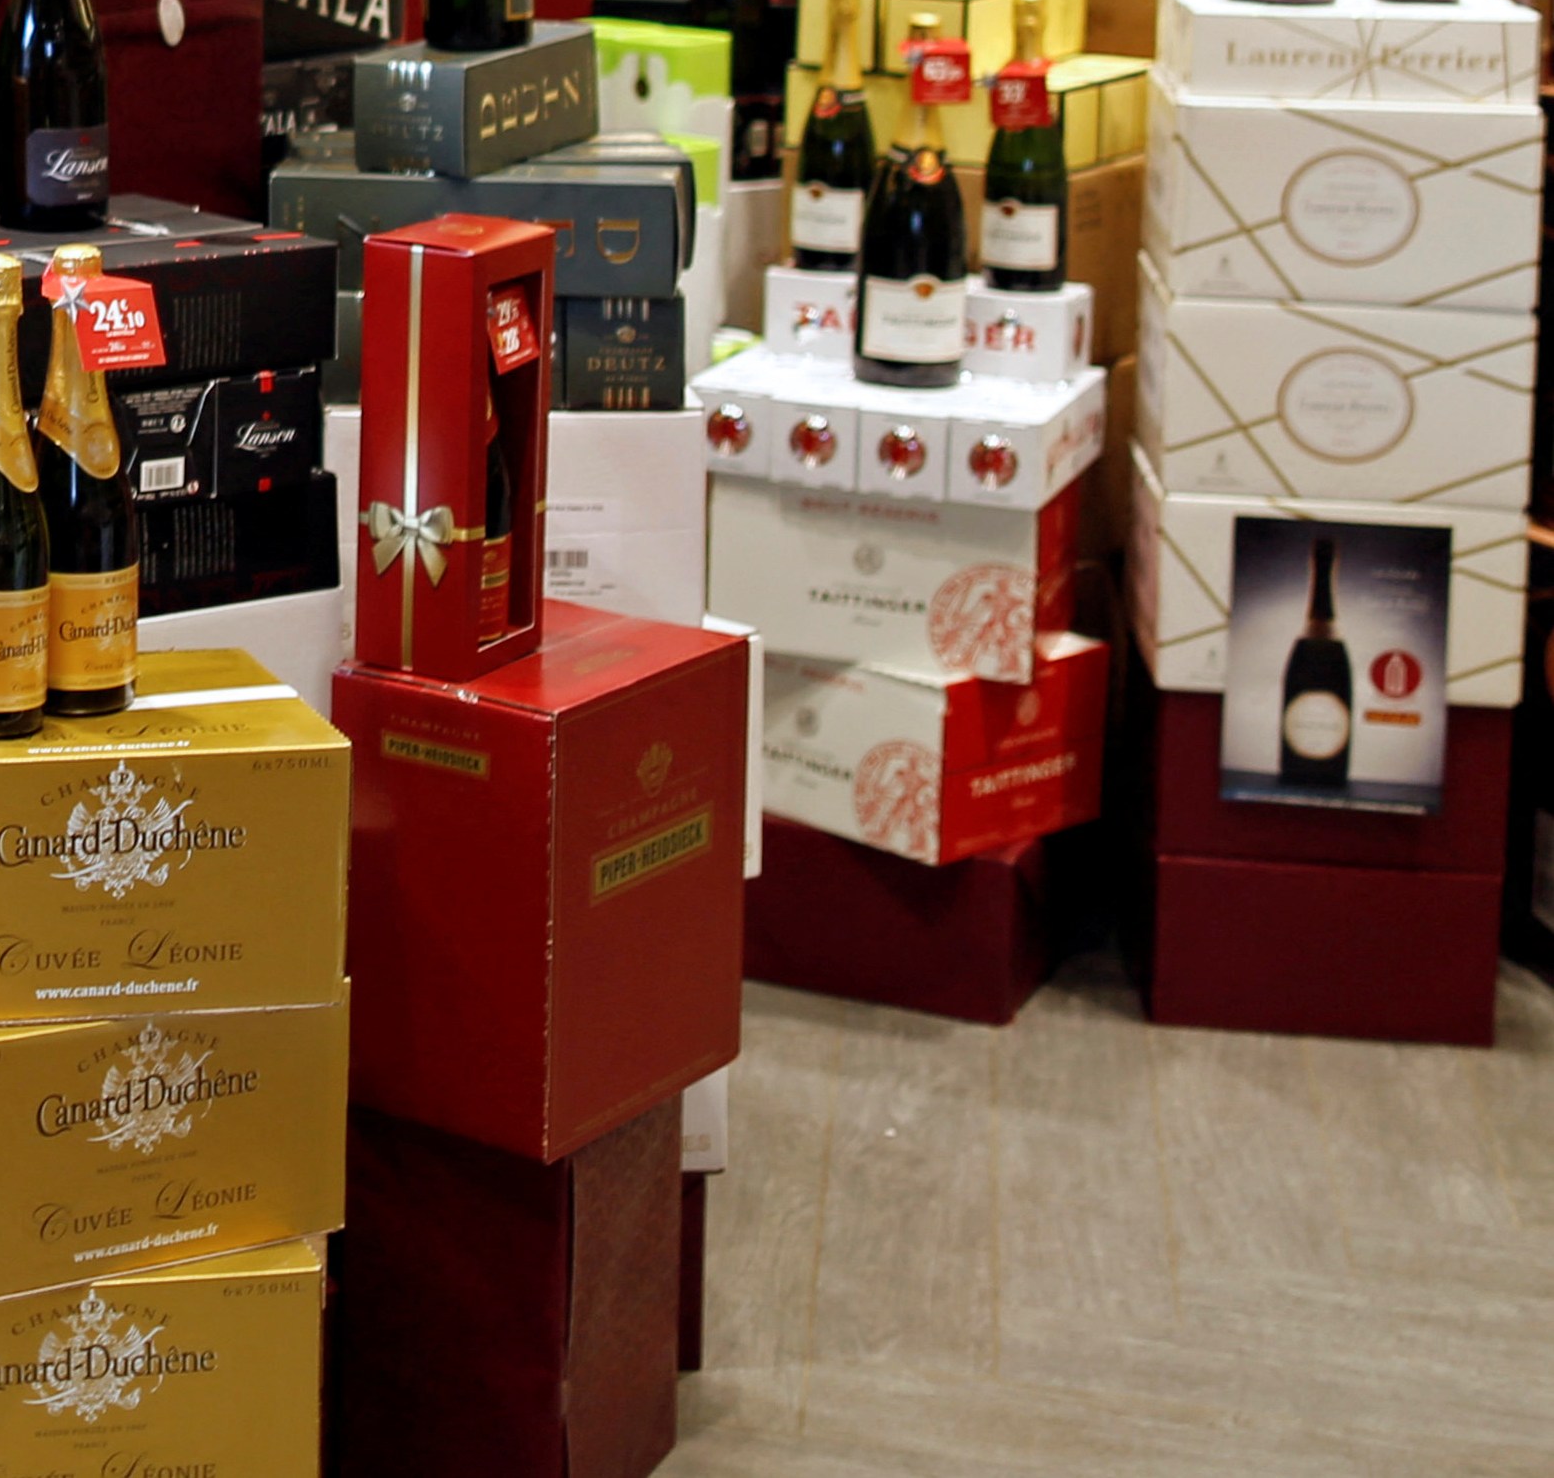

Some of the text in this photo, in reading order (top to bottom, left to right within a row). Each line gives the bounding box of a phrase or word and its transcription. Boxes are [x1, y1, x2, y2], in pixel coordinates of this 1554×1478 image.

[587, 356, 666, 373] DEUTZ
[387, 738, 481, 772] PIPER-HEIDSIECK
[40, 771, 203, 807] CHAMPAGNE
[600, 820, 703, 889] PIPER-HEIDSIECK
[120, 928, 243, 971] LÉONIE
[35, 978, 199, 1000] www.canard-duchene.fr
[77, 1029, 221, 1073] CHAMPAGNE
[36, 1067, 259, 1138] Canard-Duchêne
[32, 1180, 257, 1244] CUVÉE LÉONIE
[73, 1222, 220, 1263] www.canard-duchene.fr
[10, 1301, 174, 1337] CHAMPAGNE
